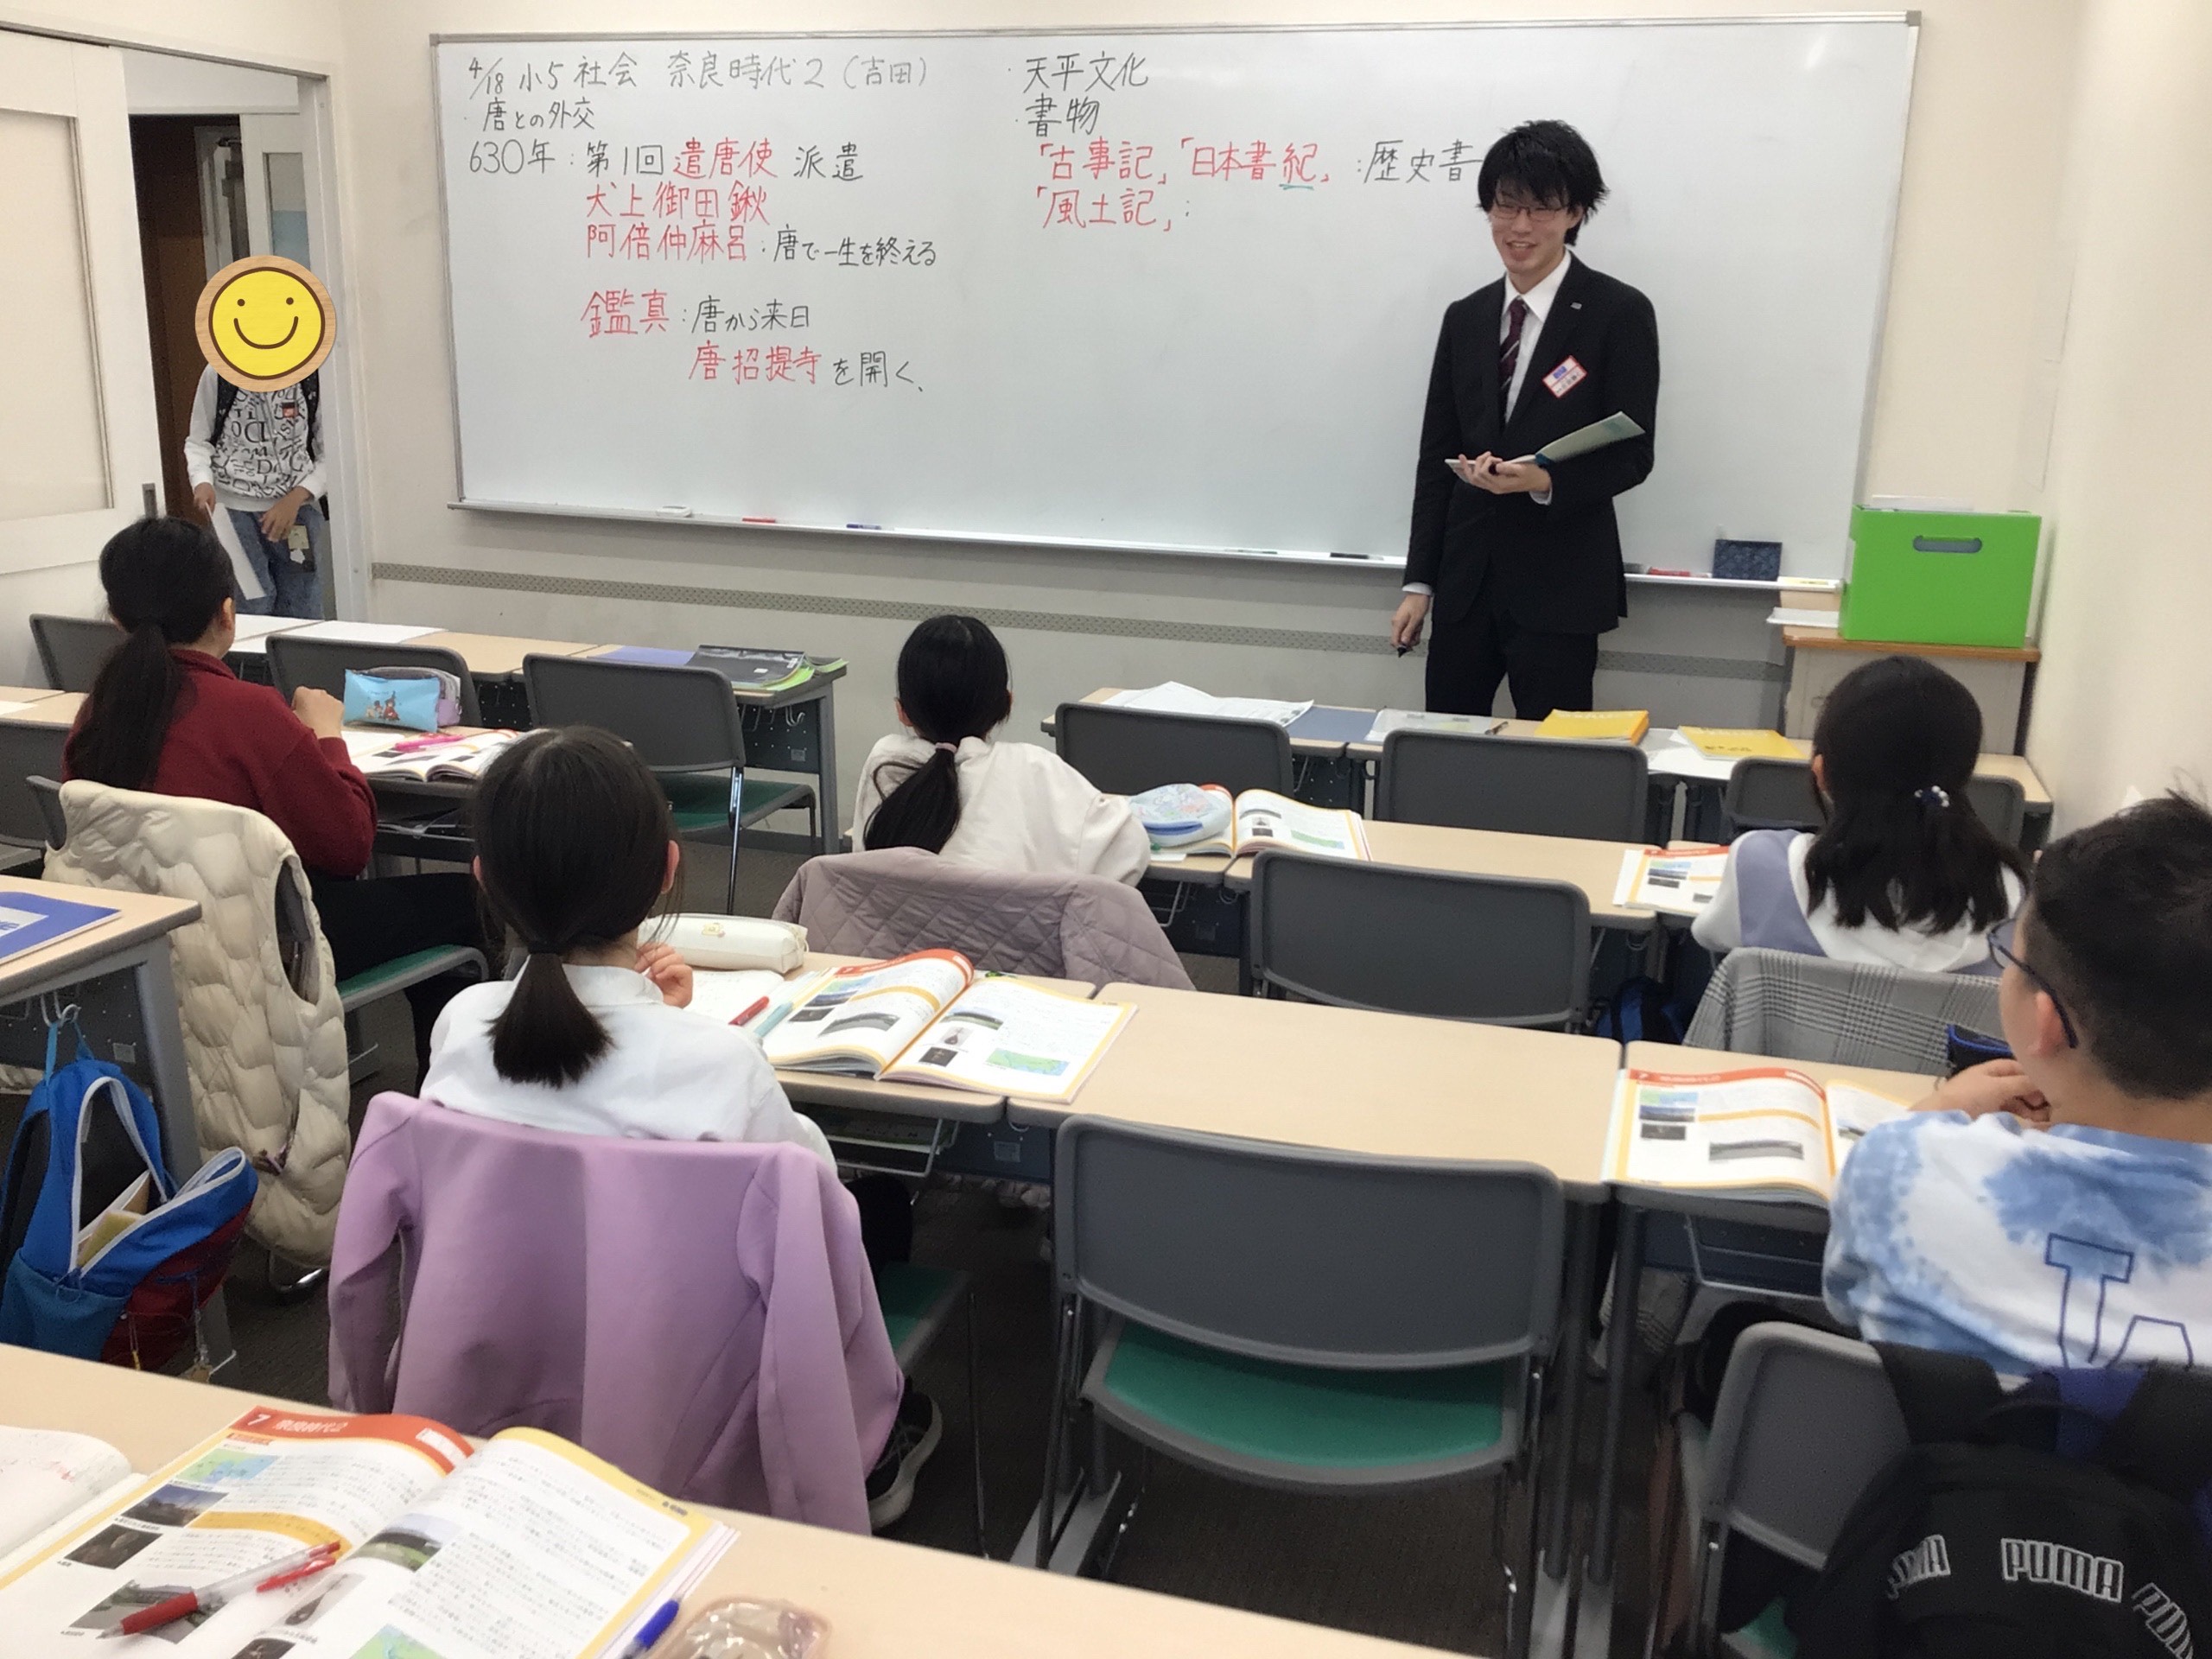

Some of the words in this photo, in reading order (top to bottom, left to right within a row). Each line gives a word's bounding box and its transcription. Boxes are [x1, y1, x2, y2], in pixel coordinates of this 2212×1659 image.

[468, 56, 505, 99] 4/18
[667, 49, 825, 90] 奈良時代2
[1022, 50, 1150, 93] 天平文化
[1024, 92, 1102, 137] 書物
[2000, 1537, 2125, 1603] PUMA
